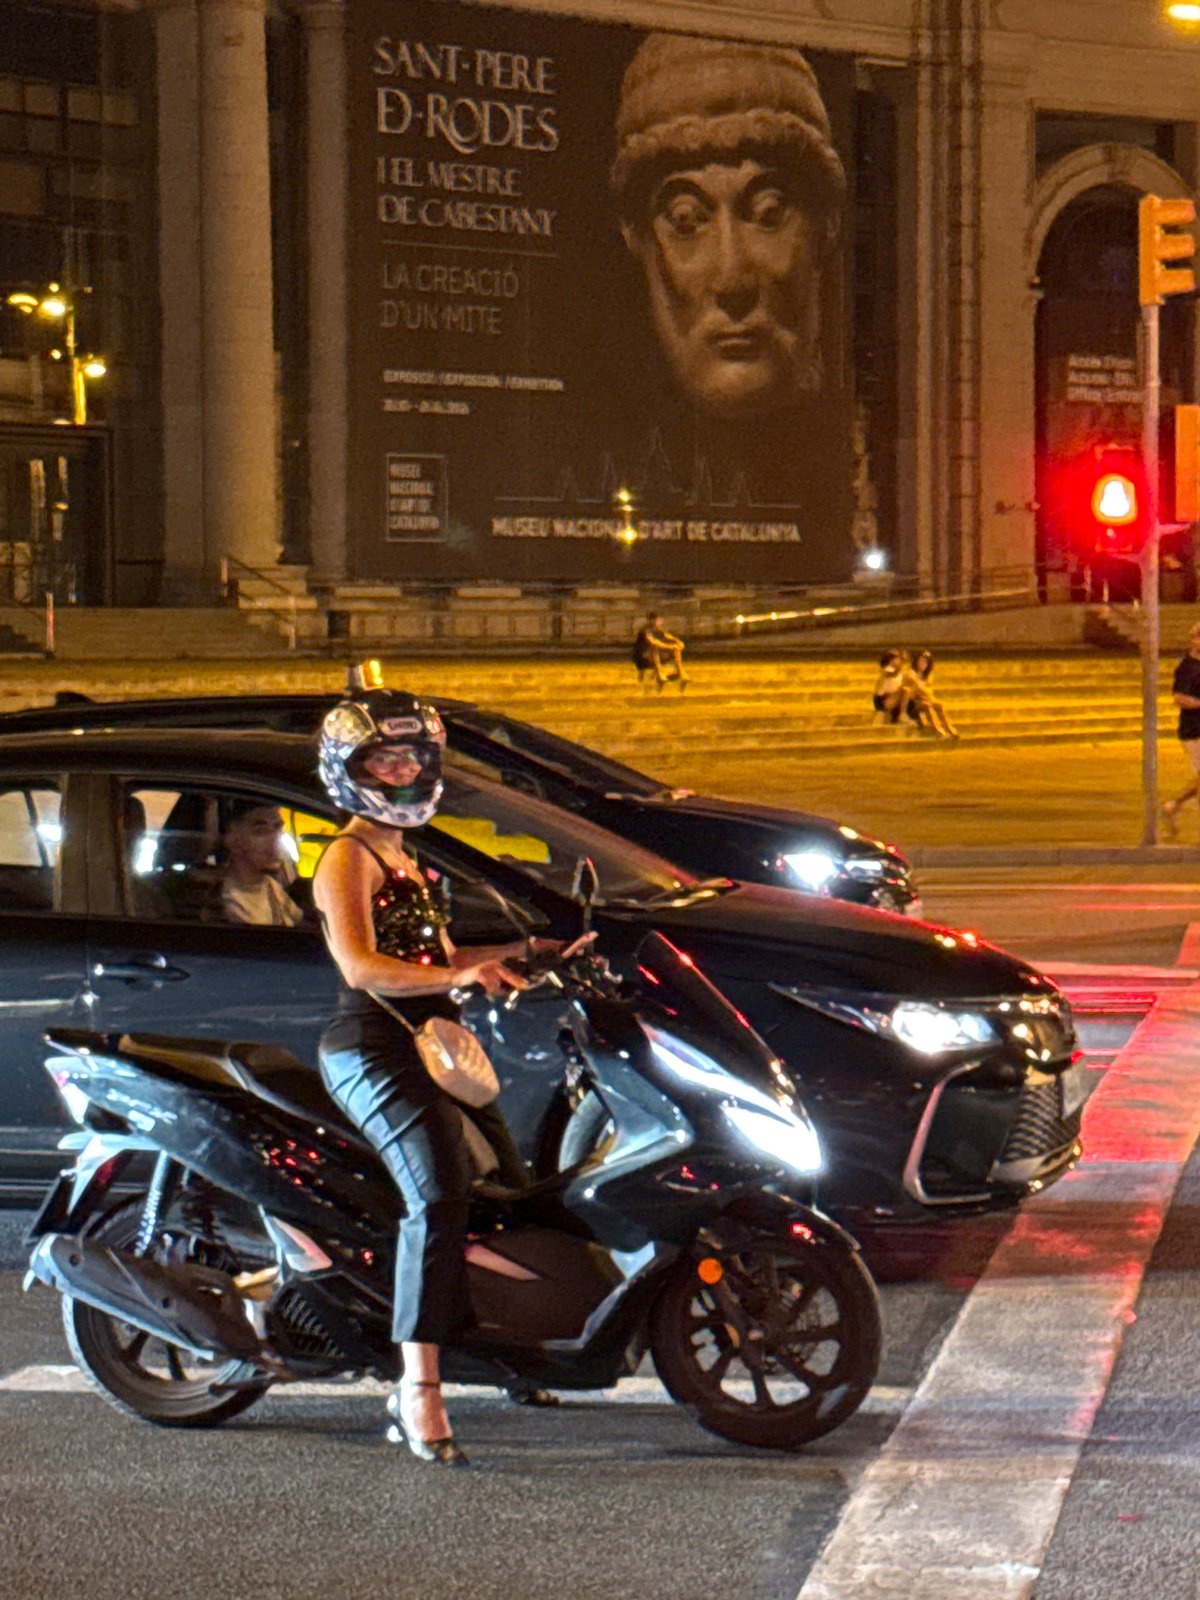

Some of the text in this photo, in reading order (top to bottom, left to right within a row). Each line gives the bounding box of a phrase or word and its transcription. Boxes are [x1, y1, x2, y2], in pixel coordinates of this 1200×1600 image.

[390, 157, 424, 187] EL
[427, 160, 523, 197] MESTRE
[377, 195, 417, 225] DE
[383, 262, 519, 299] LA CREACIÓ
[381, 300, 503, 335] D'UN MITE
[492, 517, 549, 538] MUSEU
[687, 520, 708, 541] DE
[710, 521, 801, 543] CATALUNYA
